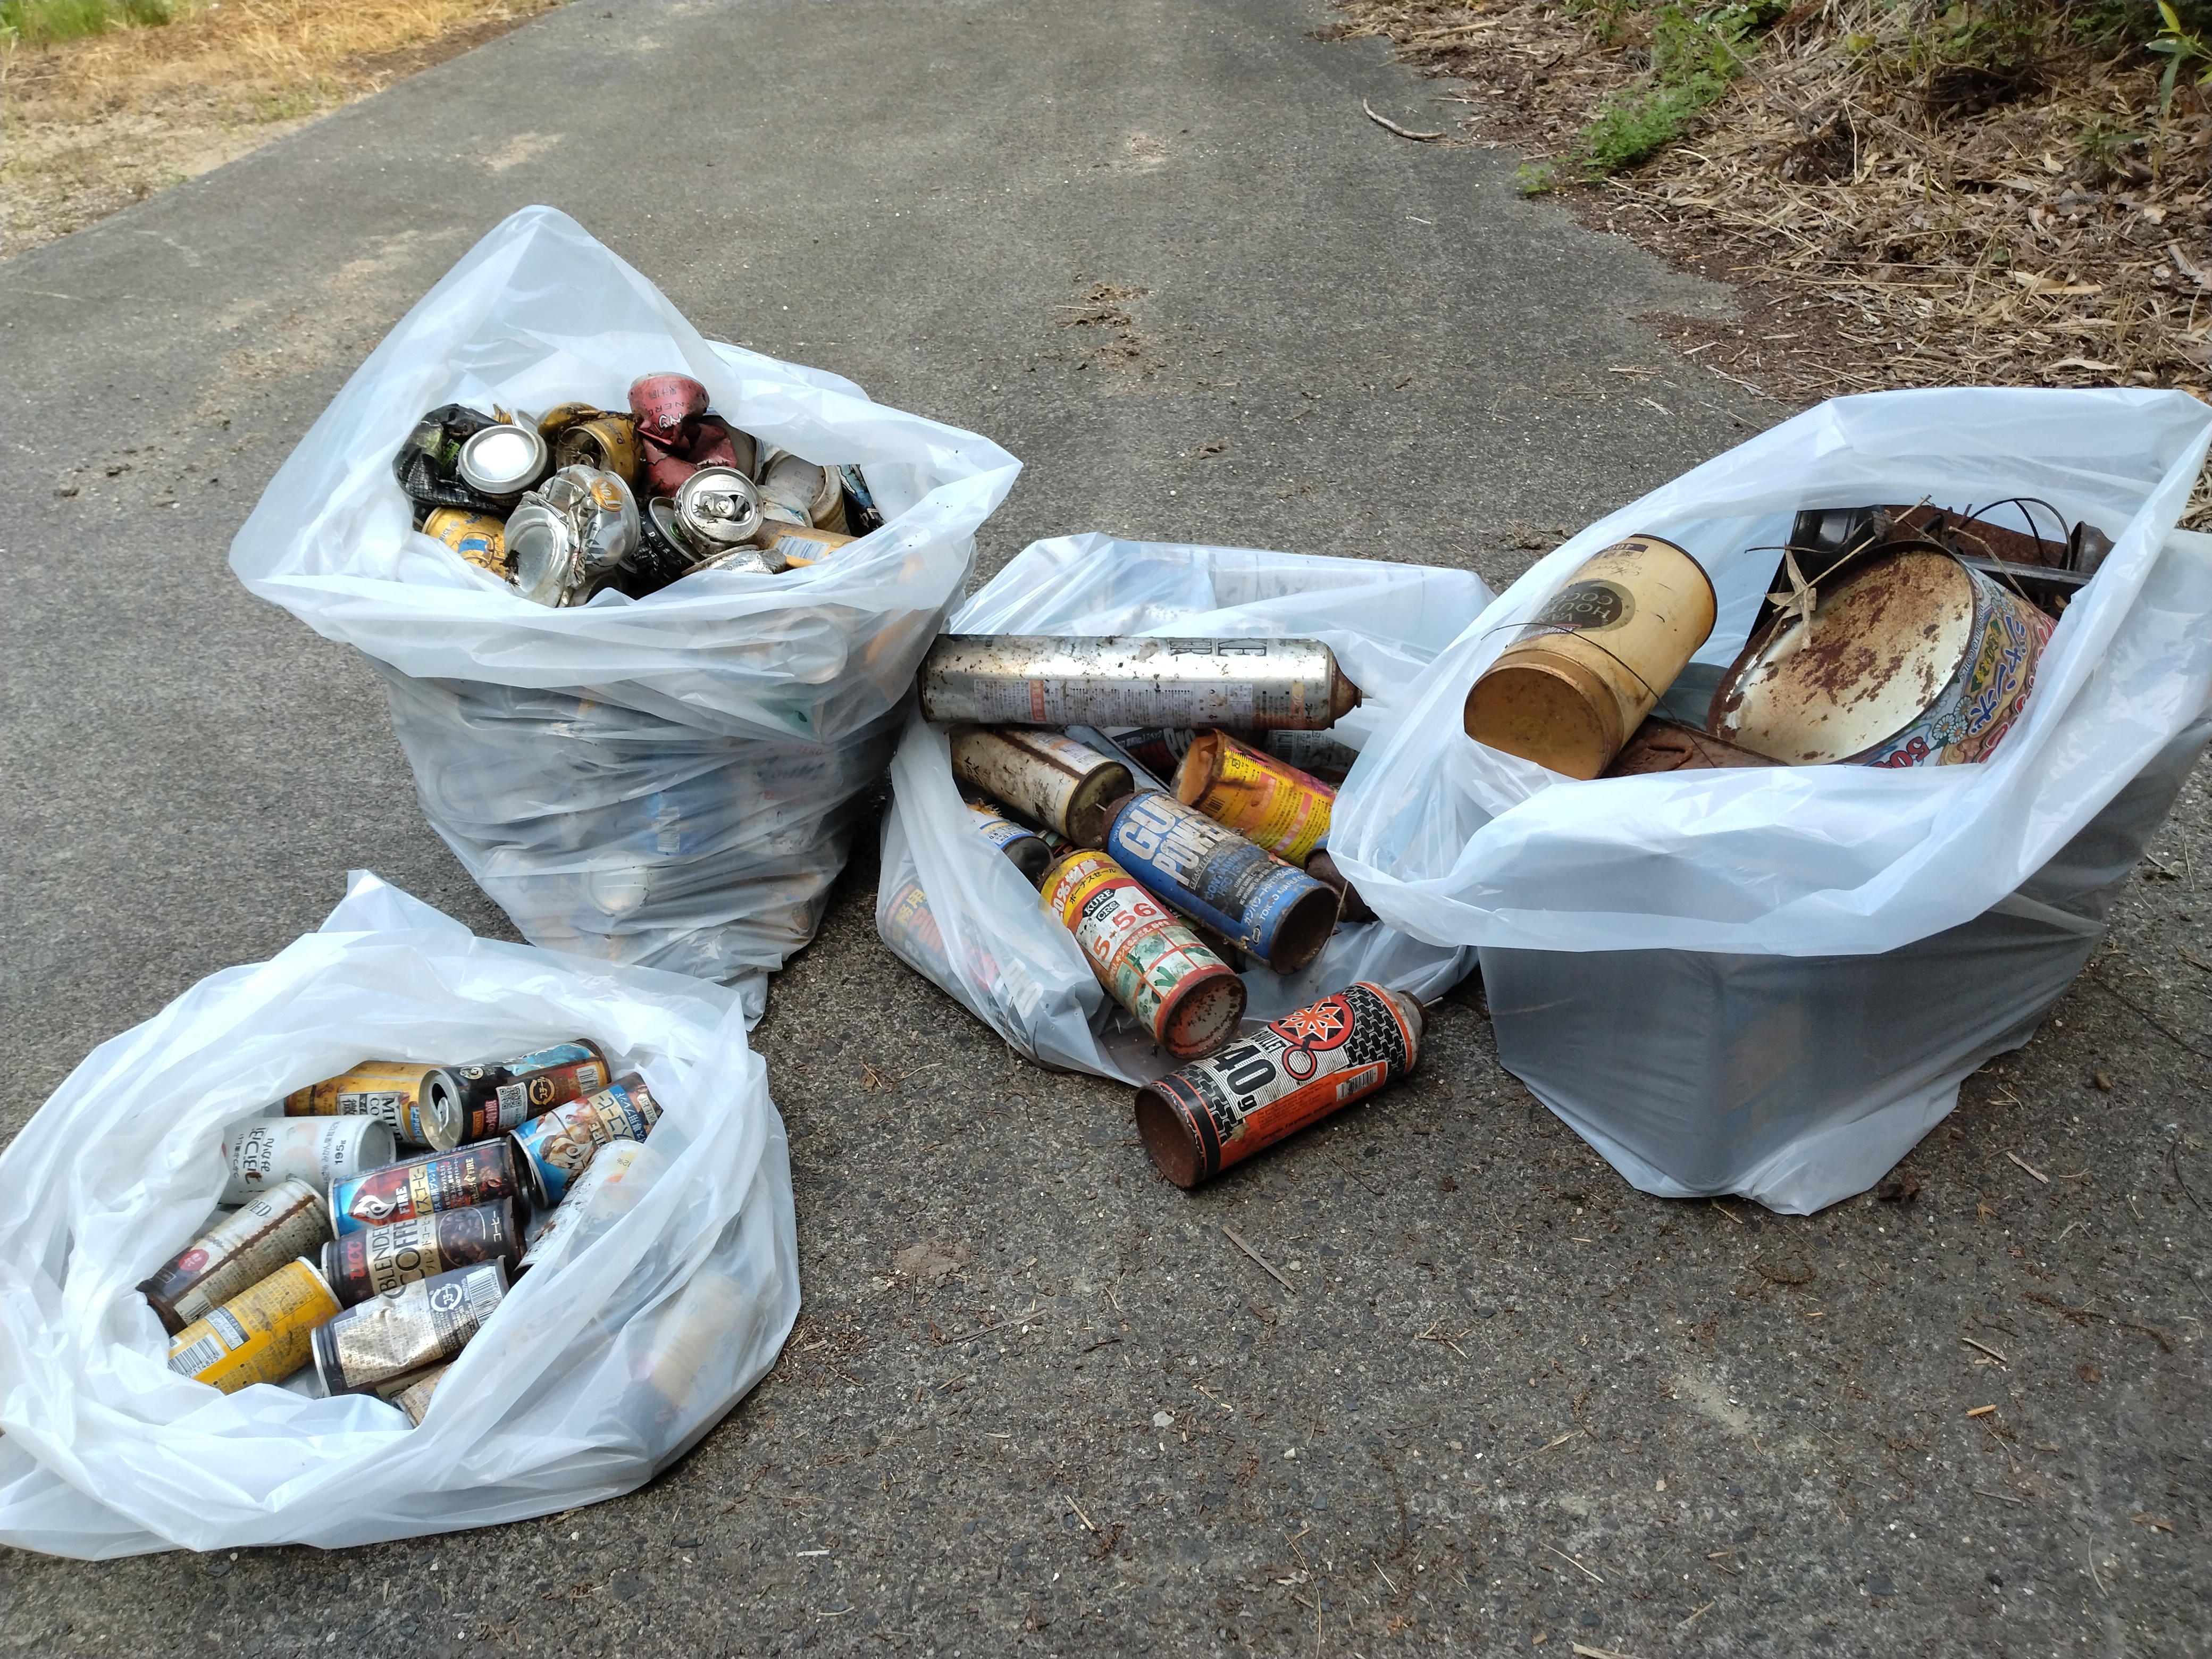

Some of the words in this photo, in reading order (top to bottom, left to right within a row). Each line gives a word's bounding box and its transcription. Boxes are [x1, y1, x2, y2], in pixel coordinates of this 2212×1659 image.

[1068, 868, 1117, 904] ボーナスセール
[1083, 889, 1114, 916] KURE
[1096, 901, 1119, 920] CRC
[1258, 893, 1280, 921] TOKO
[1089, 903, 1158, 961] 5-56
[537, 1076, 548, 1099] スチール
[260, 1137, 274, 1172] みかん
[396, 1185, 409, 1214] FIRE
[492, 1210, 502, 1242] コーヒー
